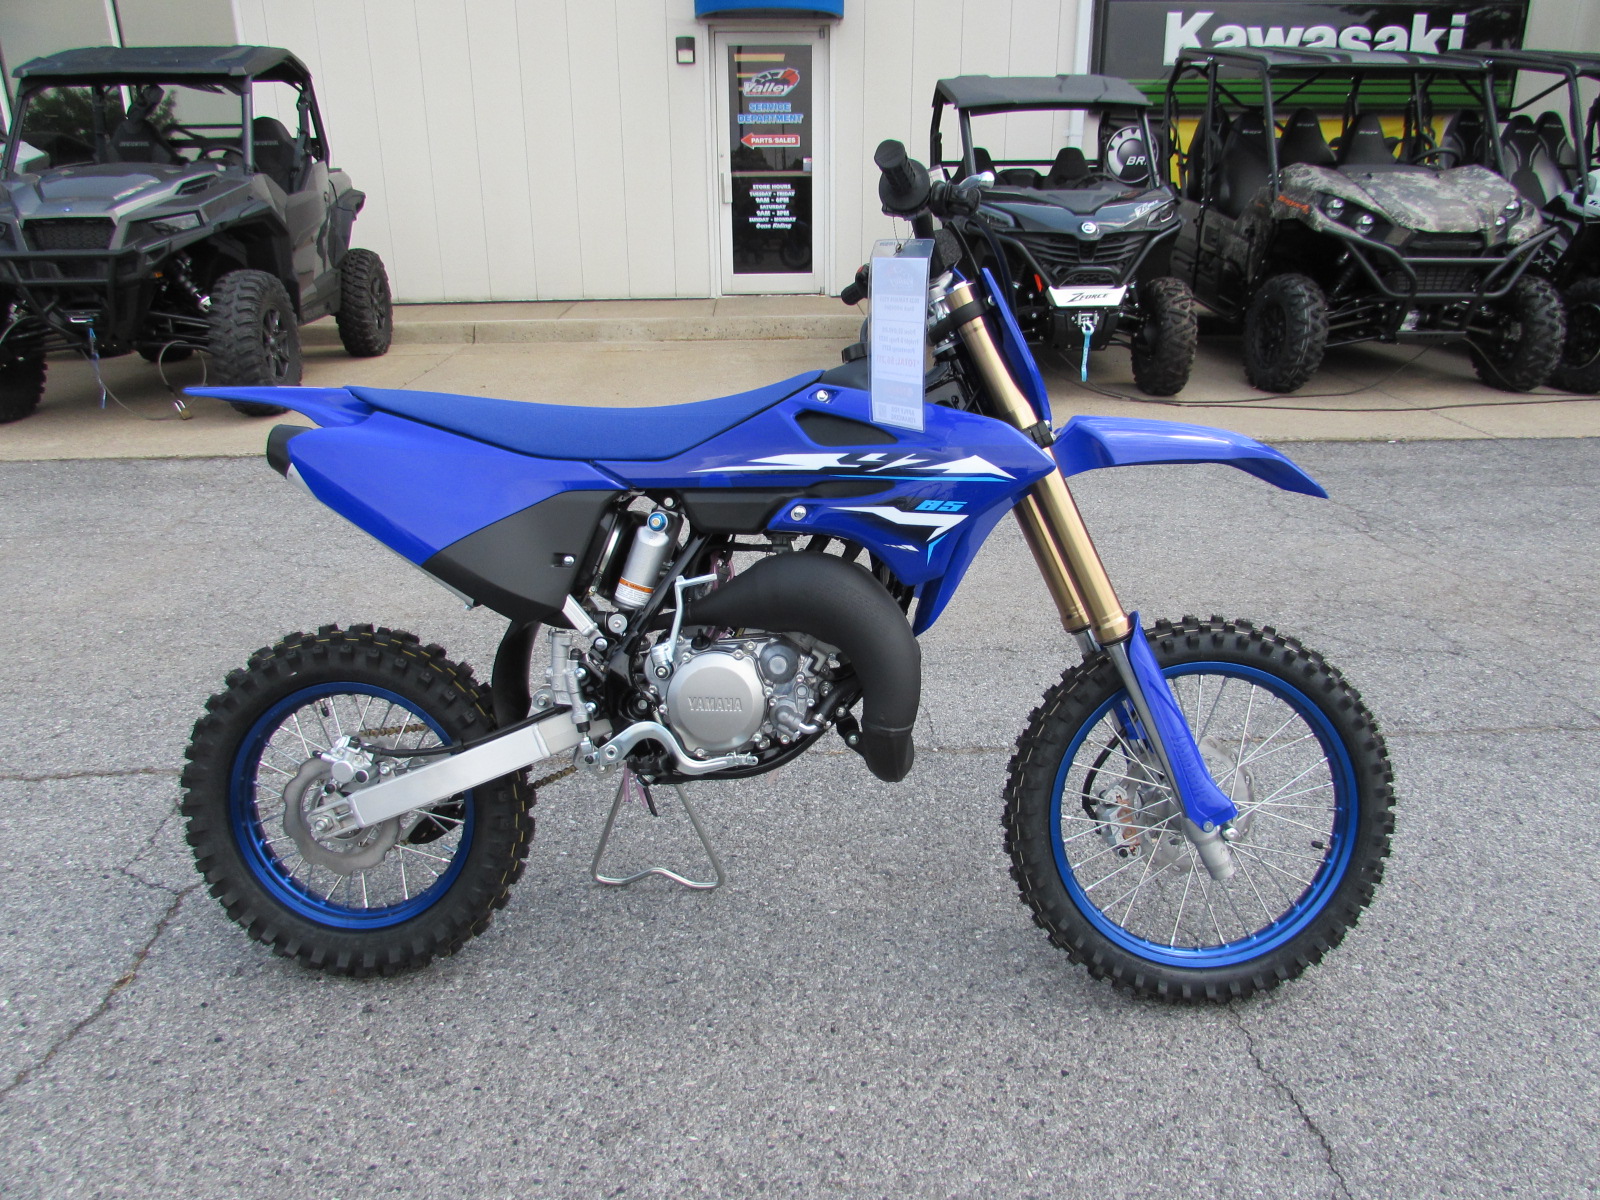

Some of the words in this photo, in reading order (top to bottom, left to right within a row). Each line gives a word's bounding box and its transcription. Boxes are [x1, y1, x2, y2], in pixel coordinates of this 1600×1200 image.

[1163, 12, 1468, 66] Kawasaki
[743, 81, 790, 95] Valley
[748, 102, 792, 112] SERVICE
[737, 114, 804, 124] DEPARTMENT
[1126, 156, 1147, 166] BR
[915, 499, 968, 512] 85
[687, 696, 743, 712] YAMAHA
